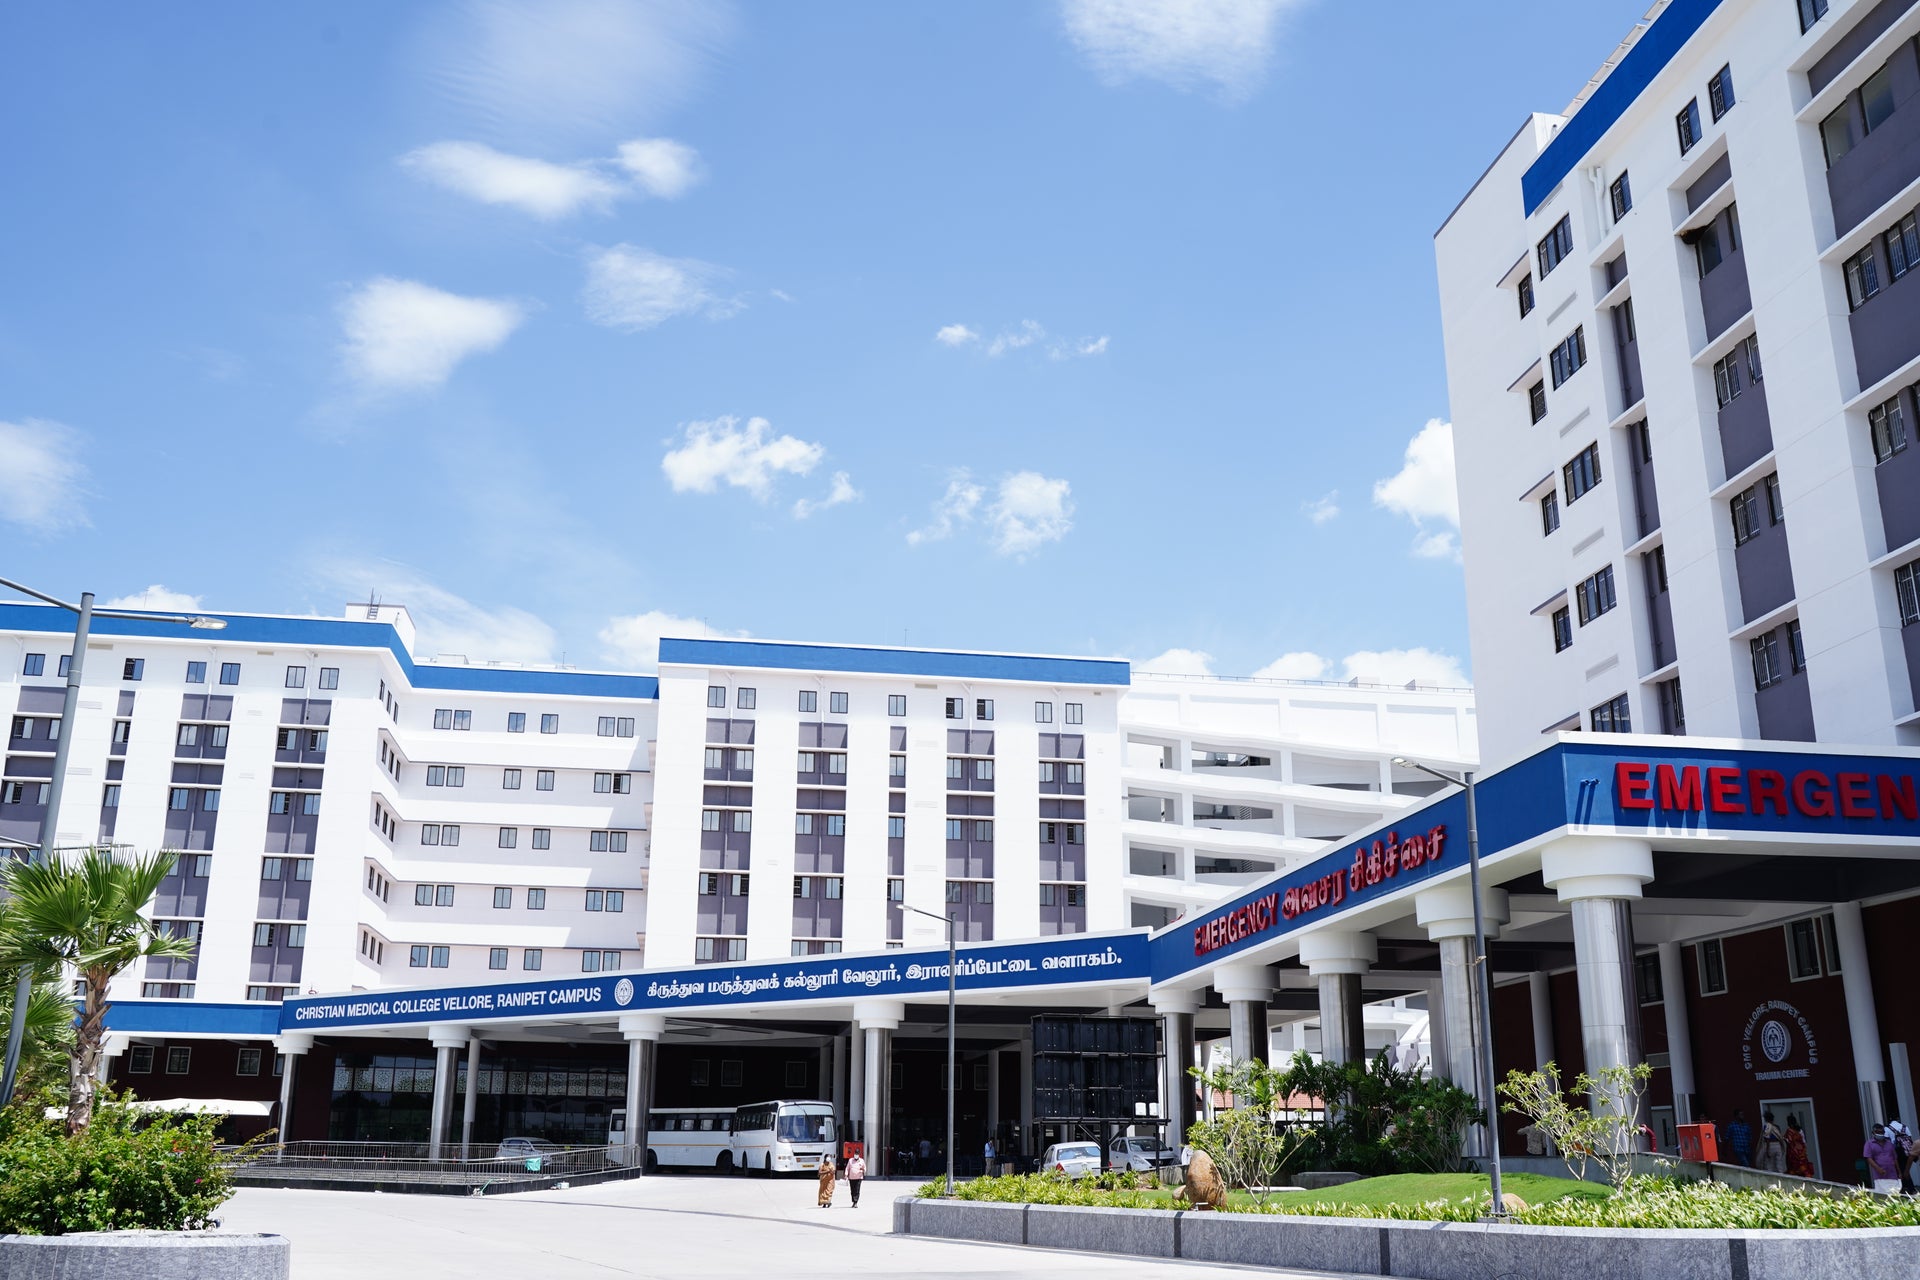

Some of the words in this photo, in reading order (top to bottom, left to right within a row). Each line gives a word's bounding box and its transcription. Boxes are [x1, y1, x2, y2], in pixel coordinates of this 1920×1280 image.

[1194, 893, 1279, 956] EMERGENCY
[1281, 868, 1347, 919] அவசர
[1350, 824, 1447, 892] சிகிச்சை
[647, 979, 704, 999] கிருத்துவ
[708, 972, 780, 995] மருத்துவக்
[295, 1004, 345, 1020] CHRISTIAN
[347, 1001, 390, 1017] MEDICAL
[393, 998, 441, 1014] COLLEGE
[443, 995, 494, 1011] VELLORE,
[497, 991, 547, 1007] RANIPET
[549, 987, 602, 1004] CAMPUS
[1742, 1045, 1753, 1070] CMC
[1767, 1000, 1800, 1018] RANIPET
[1797, 1016, 1819, 1064] CAMPUS
[1754, 1071, 1782, 1080] TRAUMA
[1782, 1069, 1811, 1078] CENTRE
